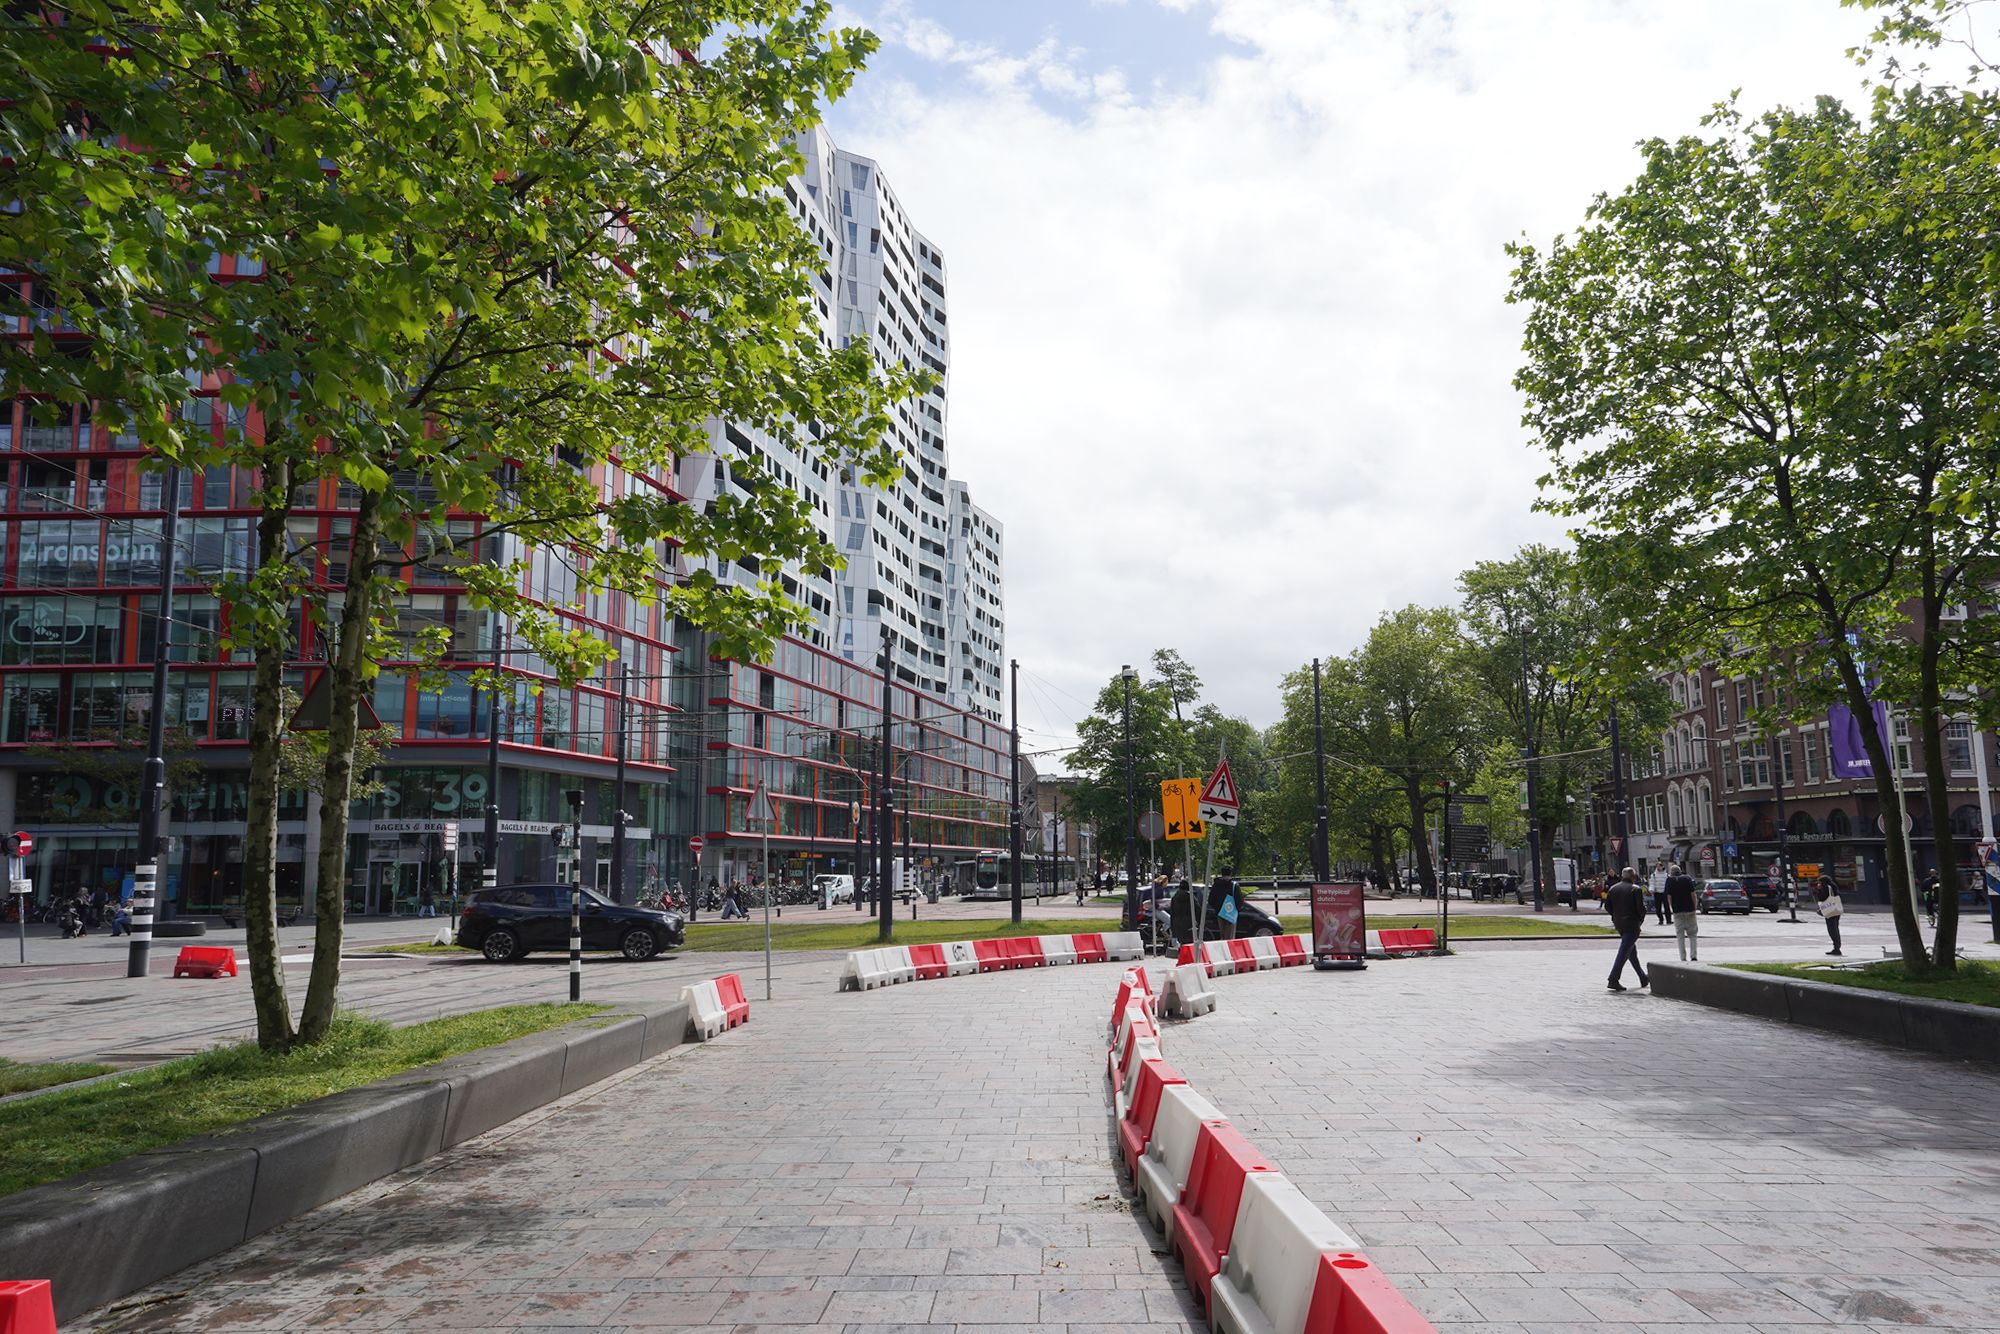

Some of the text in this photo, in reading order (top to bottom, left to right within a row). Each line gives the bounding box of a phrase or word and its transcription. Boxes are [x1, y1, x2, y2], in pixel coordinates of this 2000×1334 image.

[23, 537, 156, 562] Aronsohn
[432, 772, 488, 812] 30
[374, 823, 411, 831] BAGELS
[424, 823, 446, 831] BEA
[501, 823, 523, 832] BAGELS
[1803, 832, 1834, 841] Restaurant
